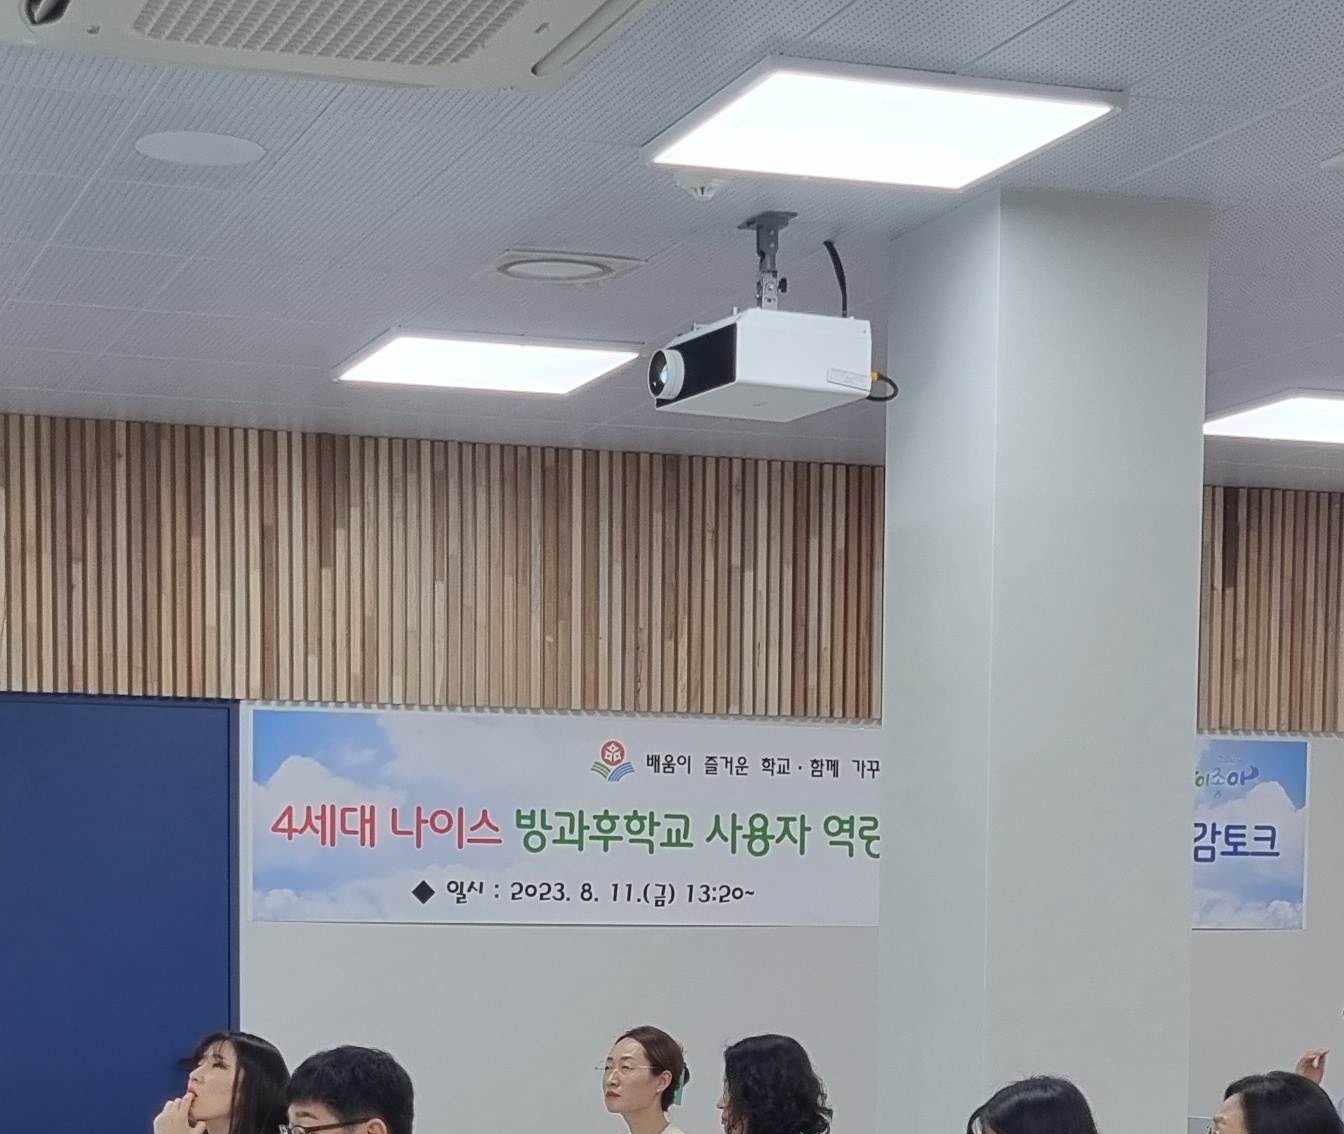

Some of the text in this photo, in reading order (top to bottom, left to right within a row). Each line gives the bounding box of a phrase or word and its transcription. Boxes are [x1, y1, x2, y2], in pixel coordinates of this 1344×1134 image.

[646, 753, 692, 775] 배움이
[703, 755, 749, 776] 즐거운
[270, 803, 376, 848] 4세대
[391, 805, 503, 850] 나이스
[515, 808, 694, 854] 방과후학교
[705, 812, 812, 858] 사용자
[1193, 821, 1281, 863] 감토크
[510, 881, 571, 902] 2023.
[579, 882, 599, 903] 8.
[610, 881, 676, 908] 11.(금)
[686, 883, 756, 904] 13:20~
